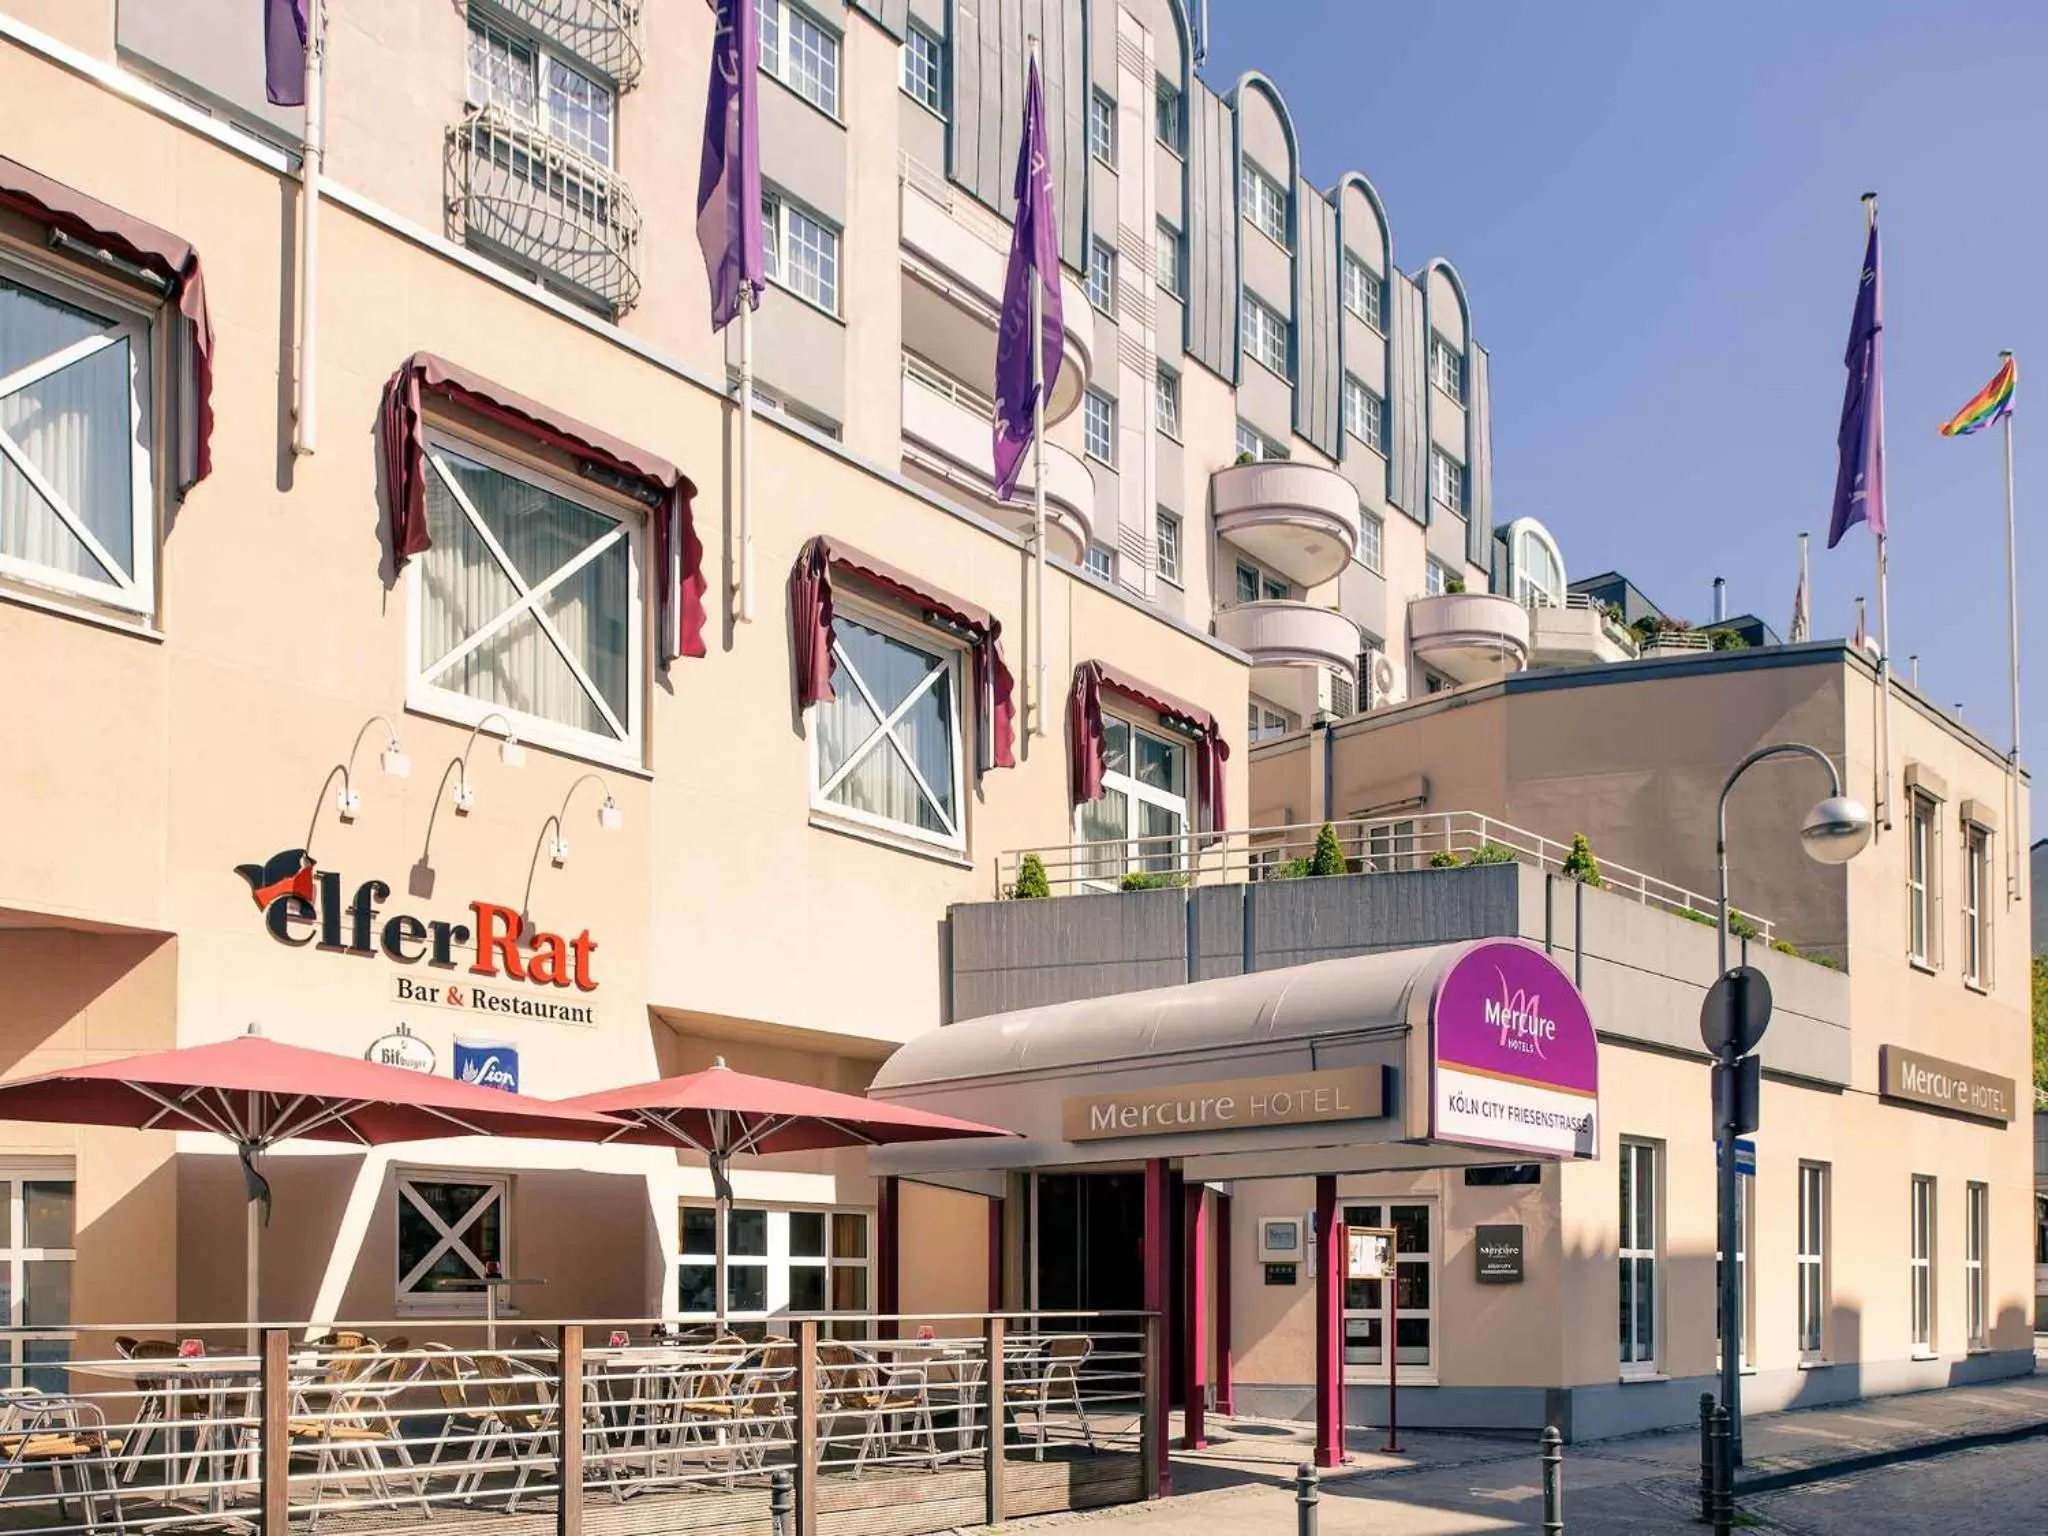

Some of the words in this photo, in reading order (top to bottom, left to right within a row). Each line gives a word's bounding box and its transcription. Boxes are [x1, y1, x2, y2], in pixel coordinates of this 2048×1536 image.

[267, 869, 599, 991] elferRat
[397, 977, 440, 1003] Bar
[447, 985, 464, 1007] &
[471, 987, 594, 1024] Restaurant
[1485, 997, 1556, 1041] Mercure
[1507, 1038, 1535, 1054] HOTELS
[1901, 1060, 1968, 1104] Mercure
[1971, 1083, 2008, 1113] HOTEL
[1090, 1095, 1236, 1132] Mercure
[1250, 1087, 1350, 1117] HOTEL
[1448, 1089, 1480, 1116] KÖLN
[1482, 1100, 1505, 1120] CITY
[1507, 1105, 1588, 1134] FRIESENSTRASSE
